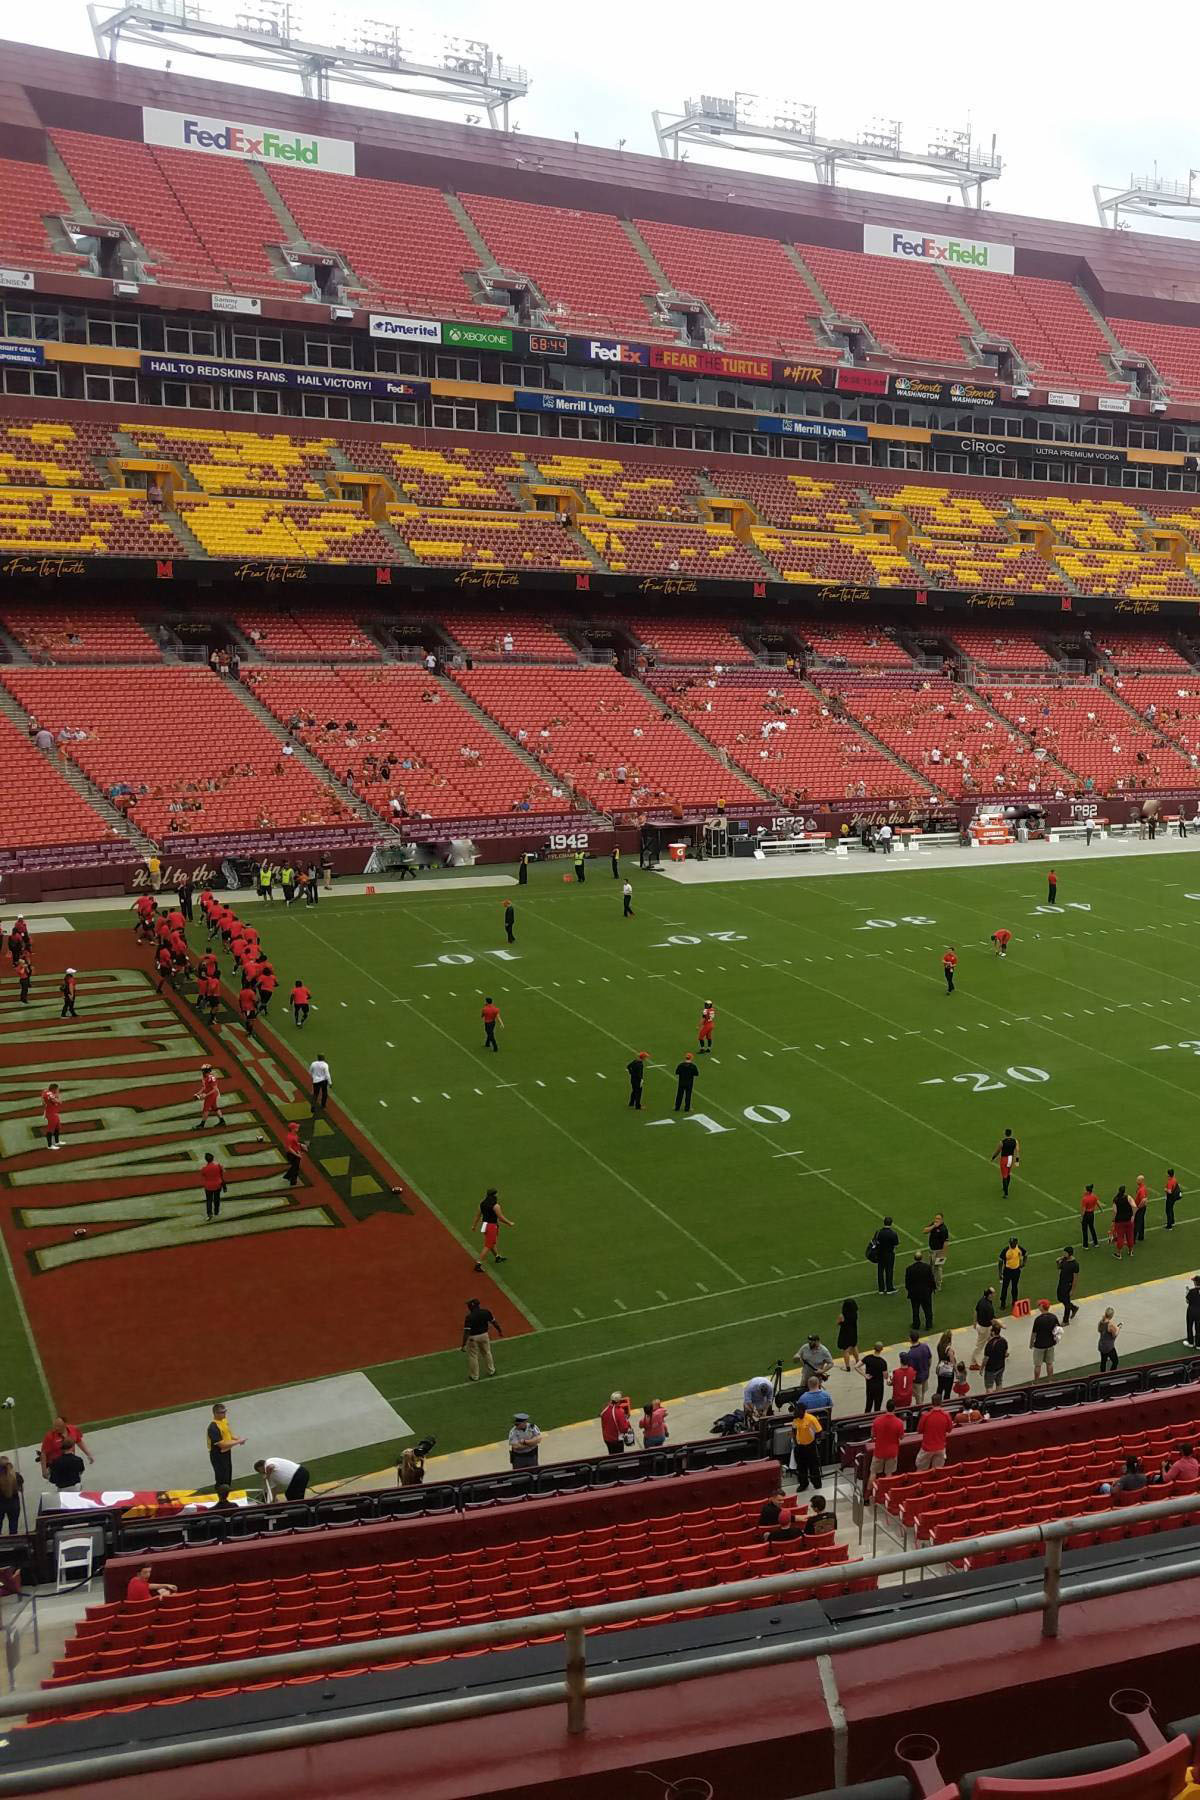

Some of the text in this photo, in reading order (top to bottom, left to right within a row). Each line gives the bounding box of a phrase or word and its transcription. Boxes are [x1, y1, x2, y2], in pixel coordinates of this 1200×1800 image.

[183, 119, 318, 165] FedExField
[891, 232, 989, 267] FedExField
[384, 321, 438, 337] Ameritel
[462, 332, 508, 345] XBOX ONE
[590, 341, 642, 364] FedEx
[151, 361, 289, 383] HAIL TO REDSKINS FANS.
[783, 365, 823, 386] #HTTR
[296, 374, 372, 391] HAIL VICTORY!
[386, 383, 416, 395] FedEx
[909, 379, 943, 393] Sports
[896, 389, 940, 401] WASHINGTON
[951, 395, 994, 406] WASHINGTON
[964, 385, 997, 400] Sports
[555, 397, 615, 415] Merrill Lynch
[793, 422, 847, 438] Merrill Lynch
[1035, 448, 1120, 461] ULTRA PREMIUM VODKA
[156, 560, 174, 577] M
[875, 812, 887, 824] to
[888, 810, 905, 824] the
[1070, 804, 1098, 818] 1982
[549, 833, 589, 850] 1942
[173, 868, 189, 884] to
[192, 863, 218, 882] the
[951, 1064, 1053, 1093] 20
[680, 1103, 793, 1136] 10
[1017, 1300, 1029, 1316] 10
